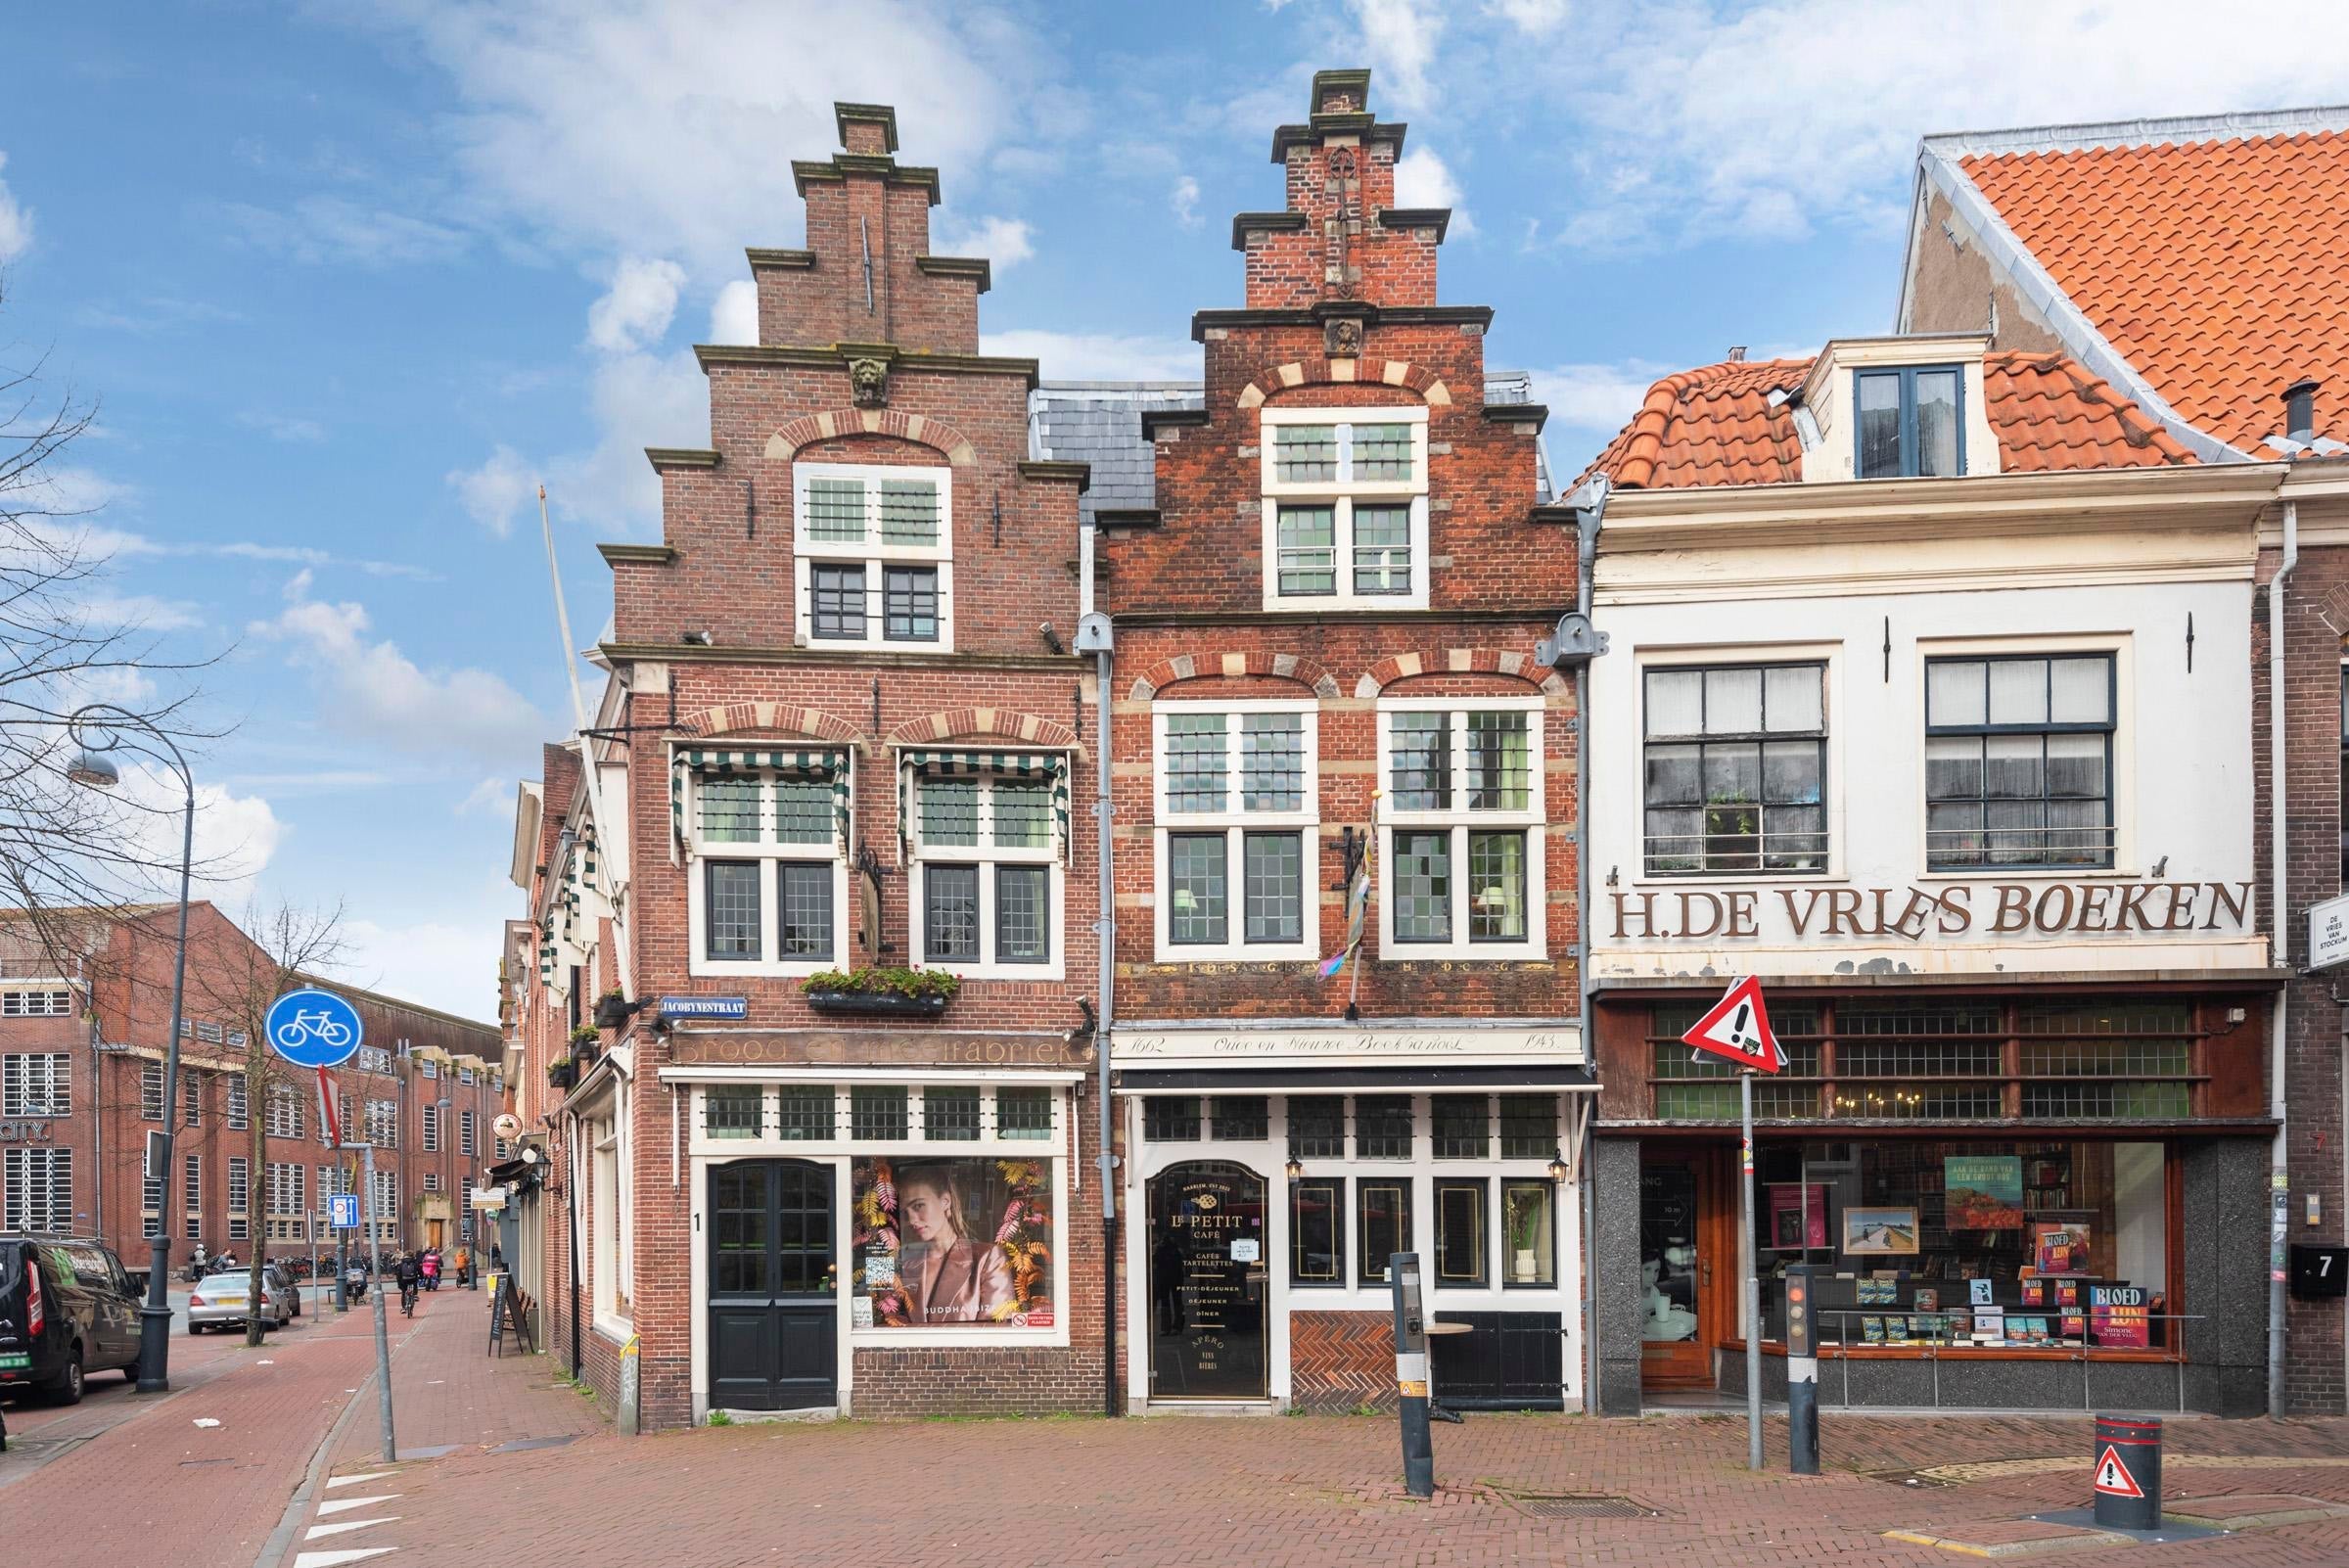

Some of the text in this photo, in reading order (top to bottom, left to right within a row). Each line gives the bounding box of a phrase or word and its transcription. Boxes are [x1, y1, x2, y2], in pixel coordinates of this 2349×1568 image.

[1773, 885, 1972, 942] VRIES
[1984, 882, 2255, 933] BOEKEN
[2329, 915, 2338, 924] DE
[2326, 922, 2343, 932] VRIES
[2320, 936, 2348, 949] STOCKUM
[661, 1000, 746, 1014] JACOBYNESTRAAT
[1129, 1038, 1166, 1053] 1662
[694, 1213, 700, 1231] 1
[1172, 1215, 1184, 1227] LE
[1191, 1215, 1243, 1227] PETIT
[1194, 1230, 1221, 1239] CAFÉ
[2045, 1234, 2069, 1247] BLOED
[2320, 1256, 2332, 1277] 7
[2096, 1288, 2141, 1306] BLOED
[923, 1305, 966, 1315] BUDDHA
[1191, 1334, 1224, 1349] APÉRO
